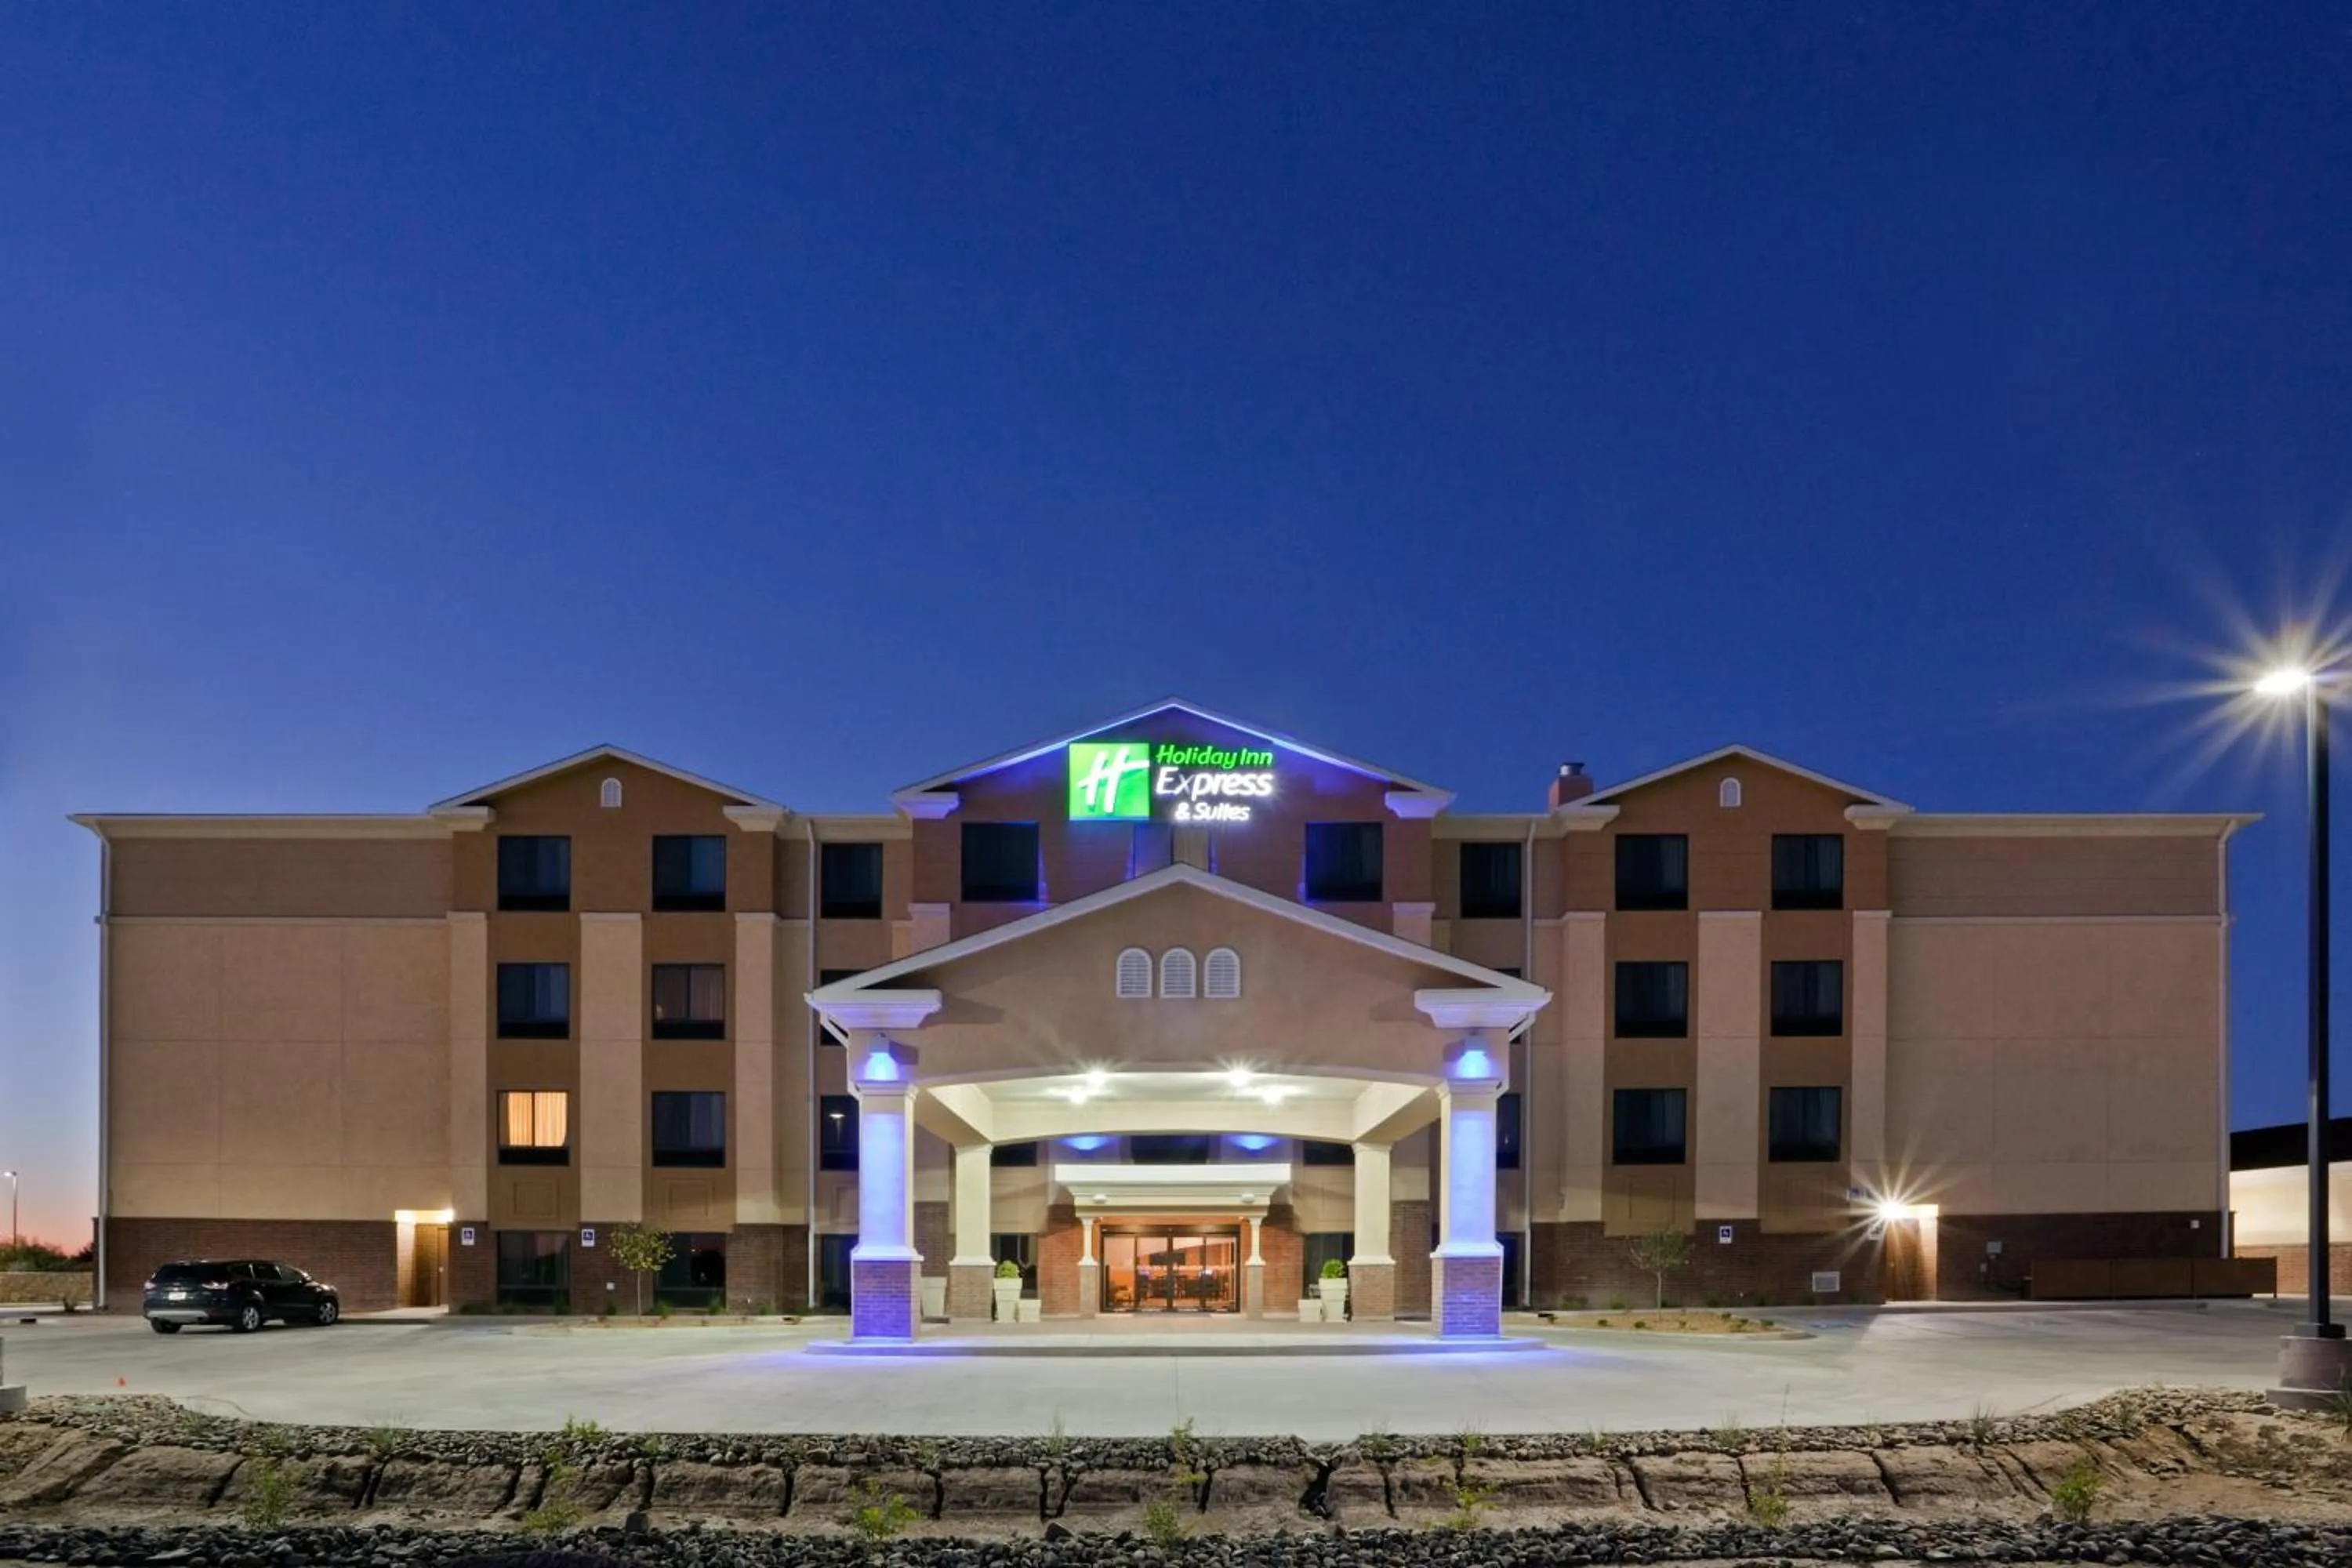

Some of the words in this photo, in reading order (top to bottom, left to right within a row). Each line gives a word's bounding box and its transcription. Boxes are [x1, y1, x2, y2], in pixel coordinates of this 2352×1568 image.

[1156, 744, 1236, 769] Holiday
[1240, 748, 1272, 765] Inn
[1155, 766, 1274, 801] Express
[1175, 802, 1191, 821] &
[1192, 802, 1250, 821] Suites
